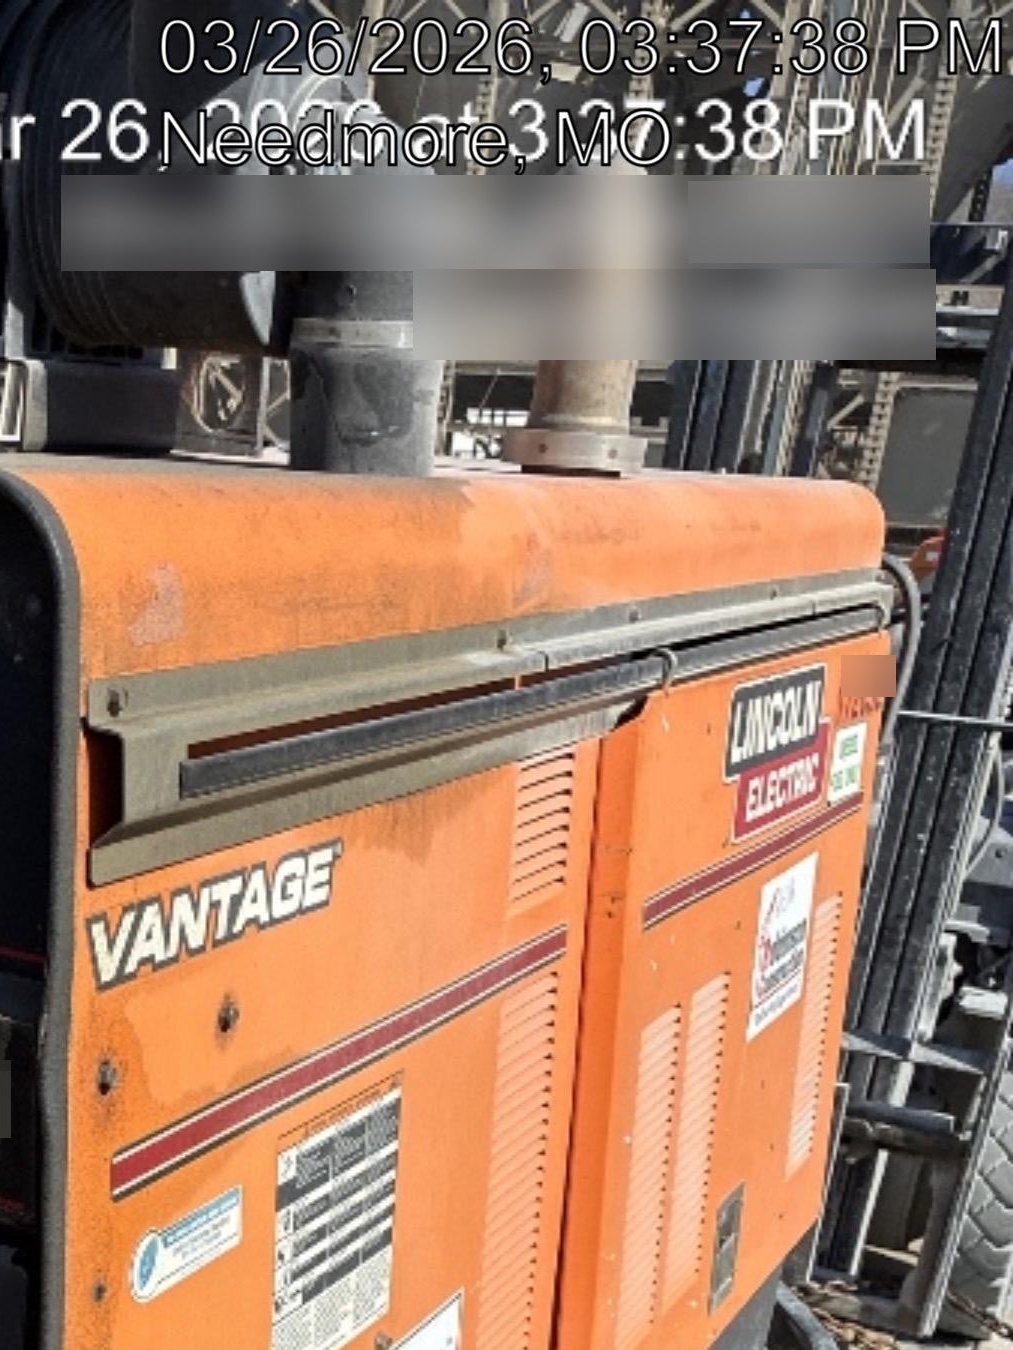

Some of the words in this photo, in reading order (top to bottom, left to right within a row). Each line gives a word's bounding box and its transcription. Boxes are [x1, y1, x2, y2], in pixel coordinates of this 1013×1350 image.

[730, 680, 823, 765] LINCOLN
[745, 751, 820, 823] ELECTRIC
[87, 844, 337, 990] VANTAGE
